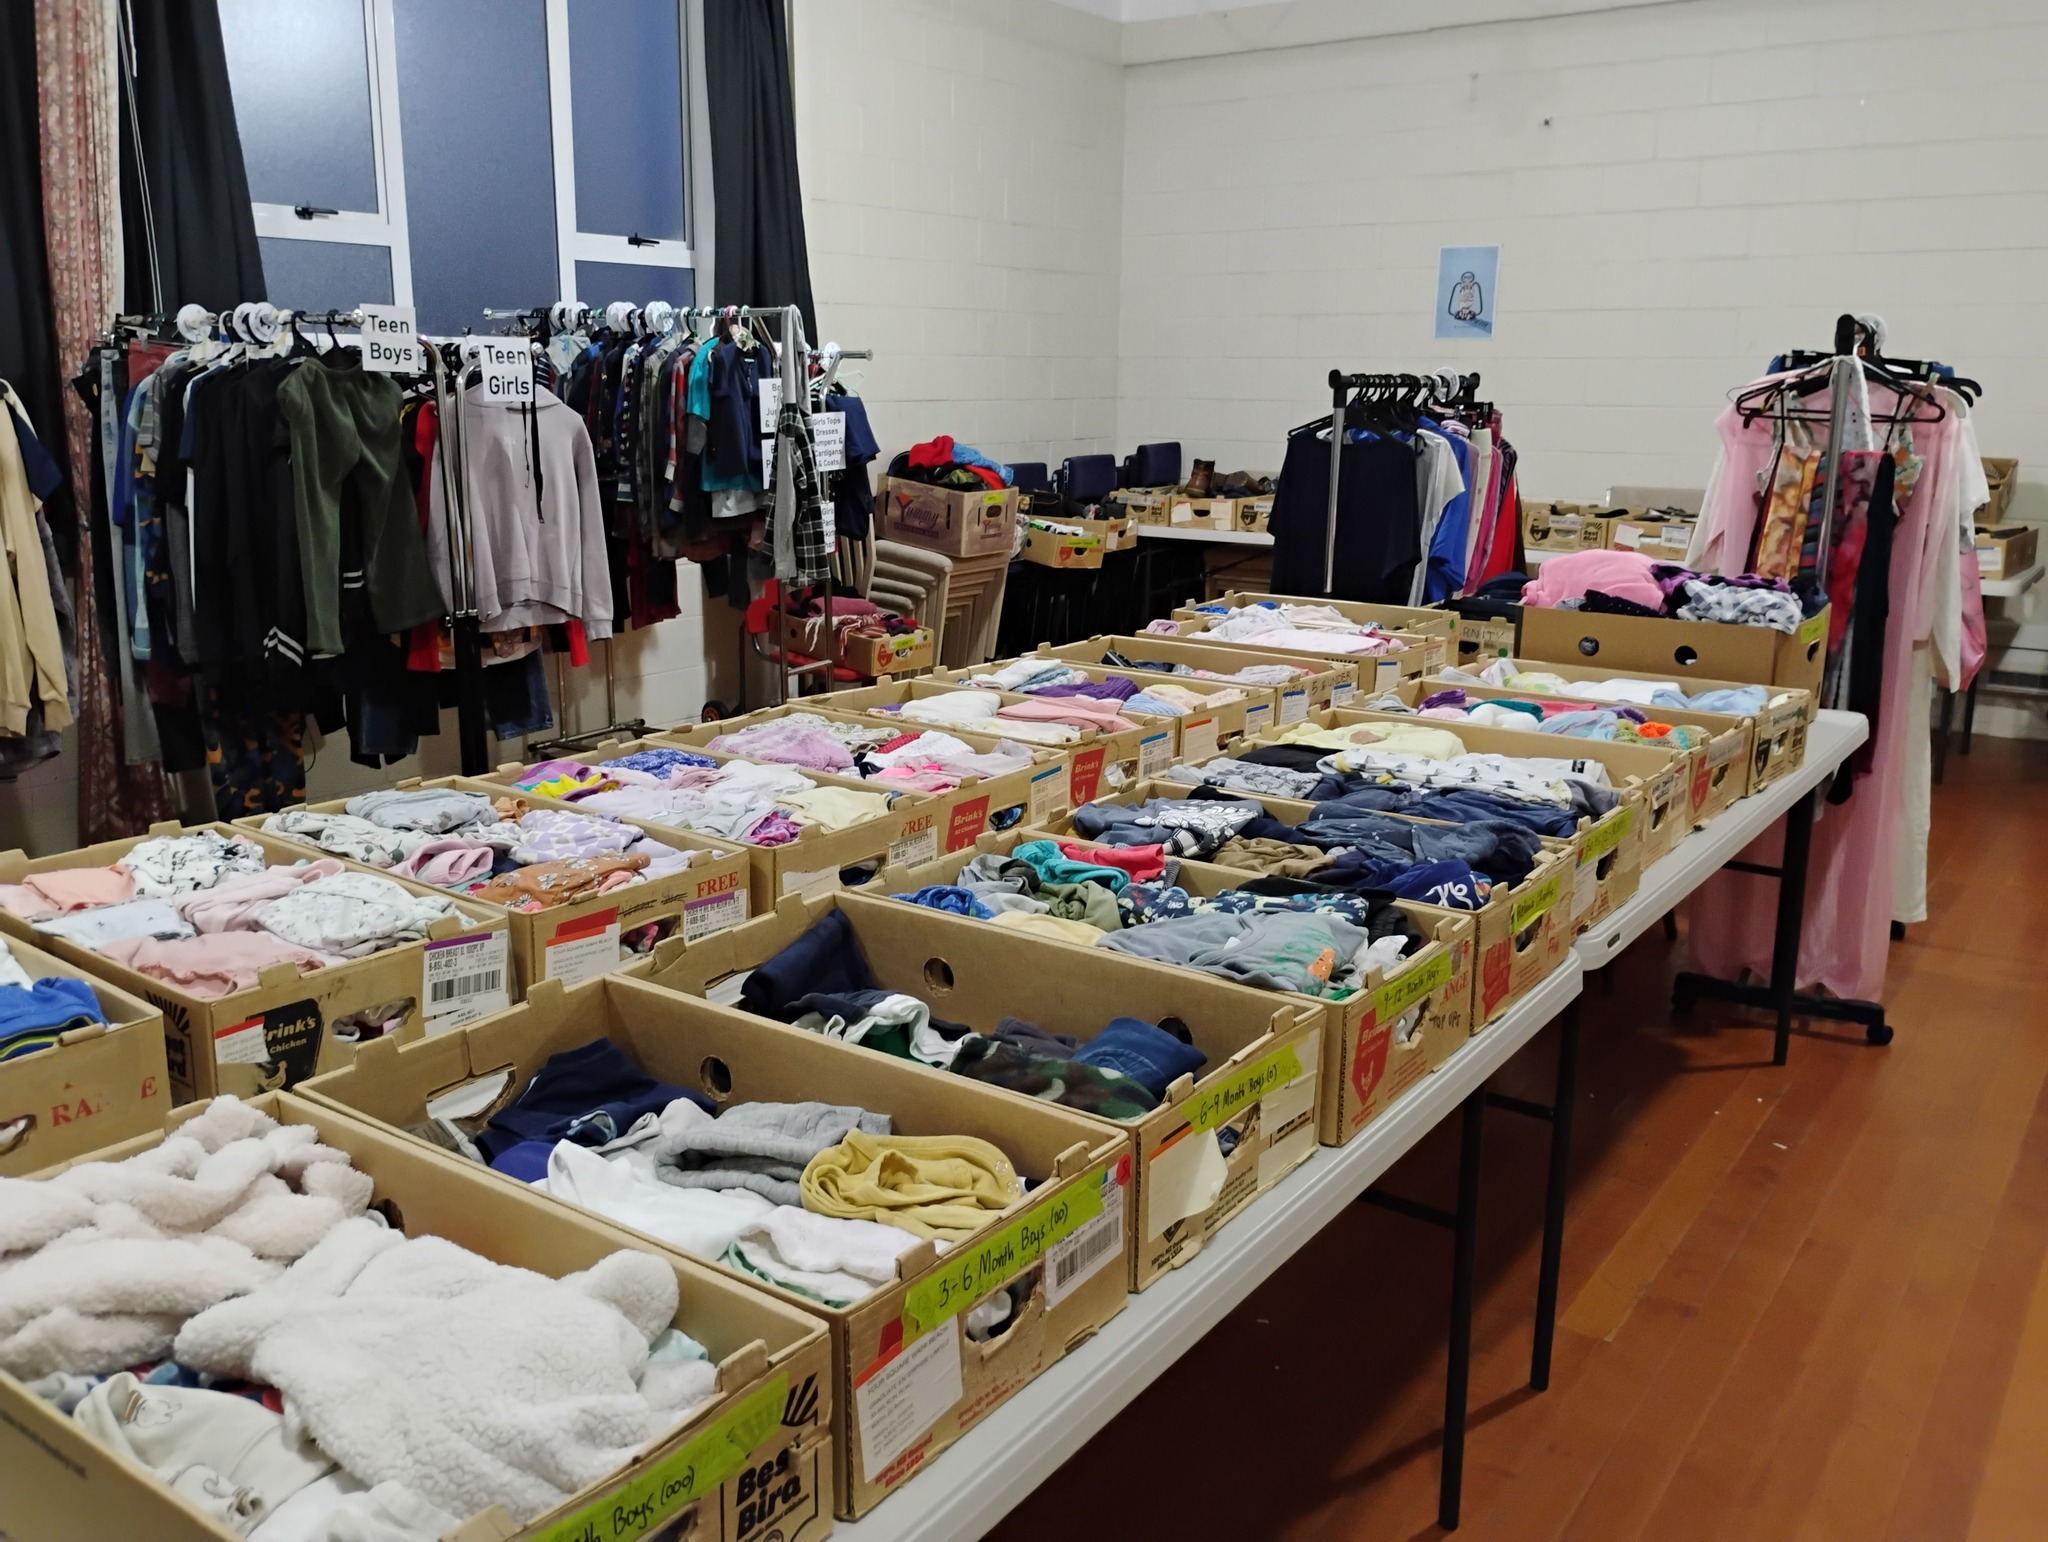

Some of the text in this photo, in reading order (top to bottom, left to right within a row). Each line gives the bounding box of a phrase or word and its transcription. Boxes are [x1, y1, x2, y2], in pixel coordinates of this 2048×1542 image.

[368, 314, 410, 334] Teen
[370, 342, 412, 365] Boys
[484, 345, 527, 365] Teen
[489, 376, 529, 395] Girls
[826, 417, 841, 425] Tops
[815, 428, 839, 436] Dresses
[814, 439, 837, 448] umpers
[1312, 680, 1318, 696] 5
[1327, 671, 1352, 687] UNDER
[1075, 760, 1099, 773] Brink's
[901, 814, 933, 838] FREE
[953, 809, 983, 826] Brink's
[697, 871, 739, 898] FREE
[1429, 1013, 1446, 1030] TOP
[269, 1038, 307, 1055] Chicken
[1200, 1093, 1220, 1125] 6-9
[1222, 1083, 1245, 1110] Month
[1249, 1073, 1265, 1094] Boys
[938, 1264, 973, 1308] 3-6
[979, 1241, 1015, 1281] Month
[1021, 1226, 1046, 1254] Boys
[867, 1377, 886, 1396] FOUR
[886, 1356, 910, 1380] SQUARE
[736, 1447, 789, 1507] Bes
[613, 1464, 694, 1531] Boys (000)
